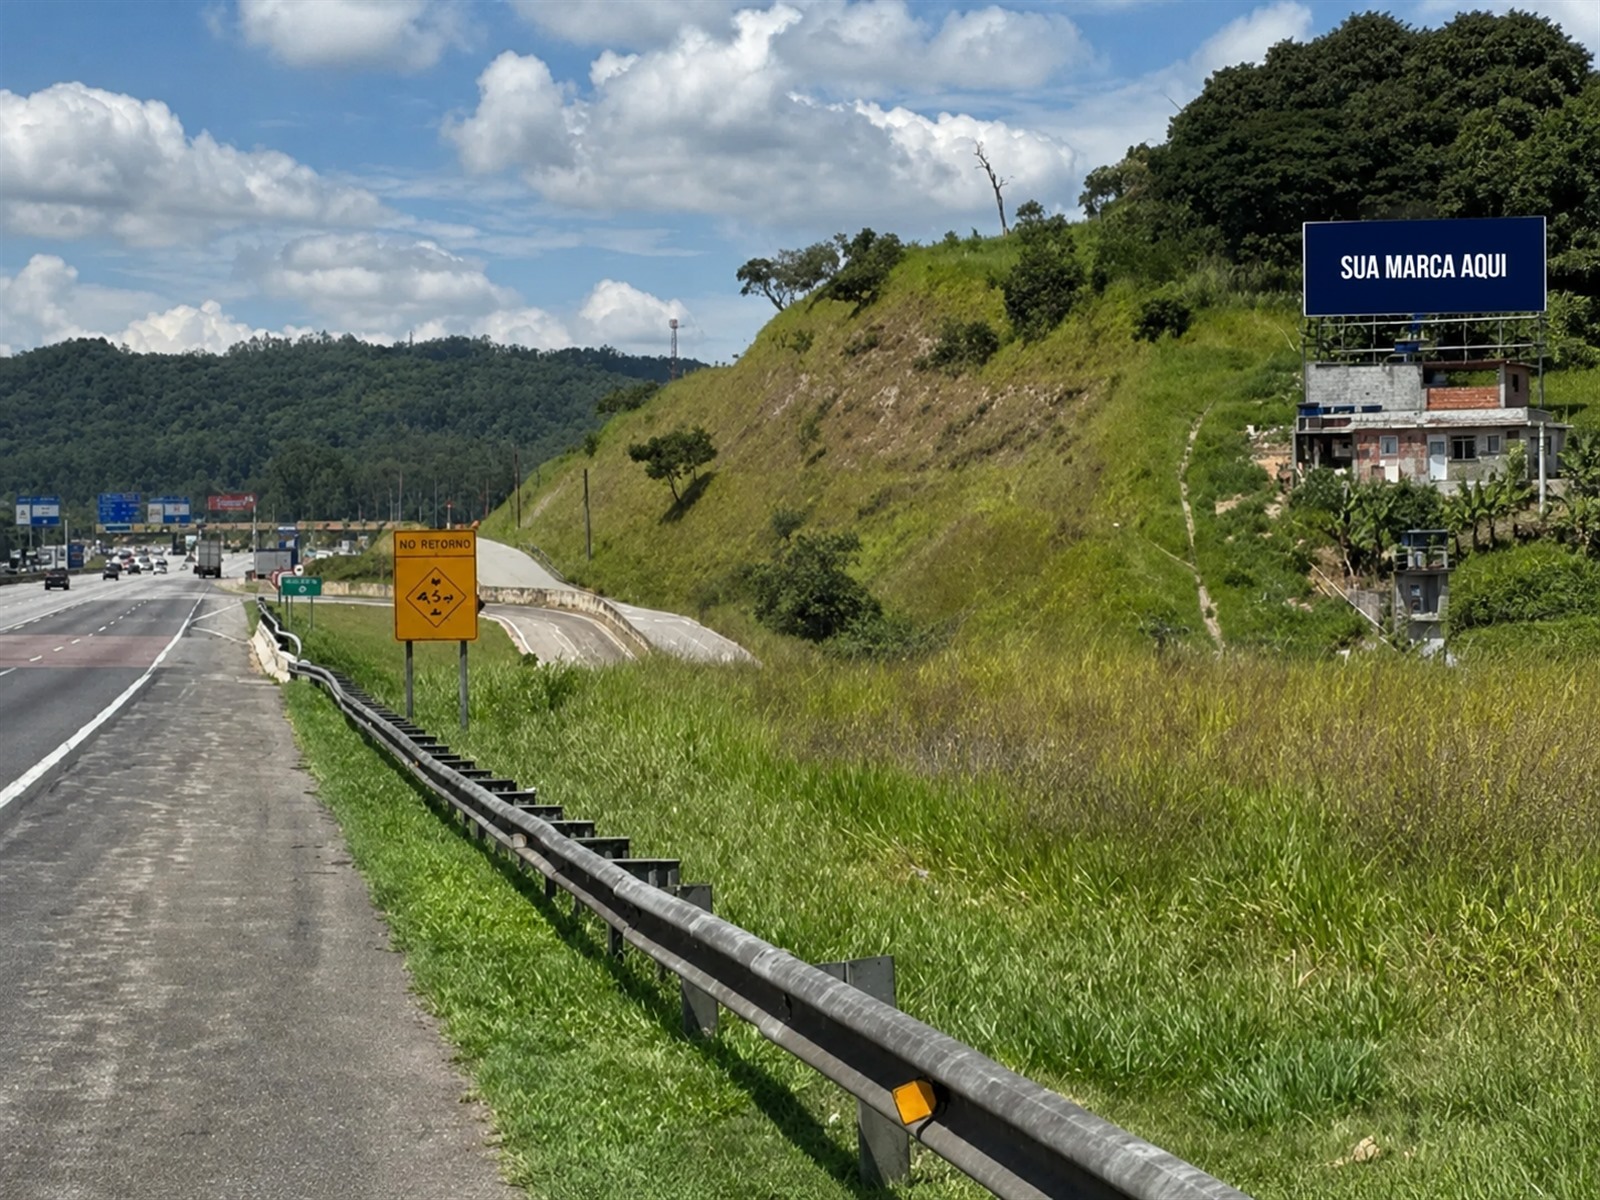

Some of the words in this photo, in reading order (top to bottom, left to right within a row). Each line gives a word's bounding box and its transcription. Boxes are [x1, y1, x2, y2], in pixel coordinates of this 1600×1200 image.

[1340, 255, 1380, 279] SUA
[1385, 254, 1456, 279] MARCA
[1460, 253, 1507, 279] AQUI
[399, 539, 416, 549] NO
[421, 539, 471, 549] RETORNO
